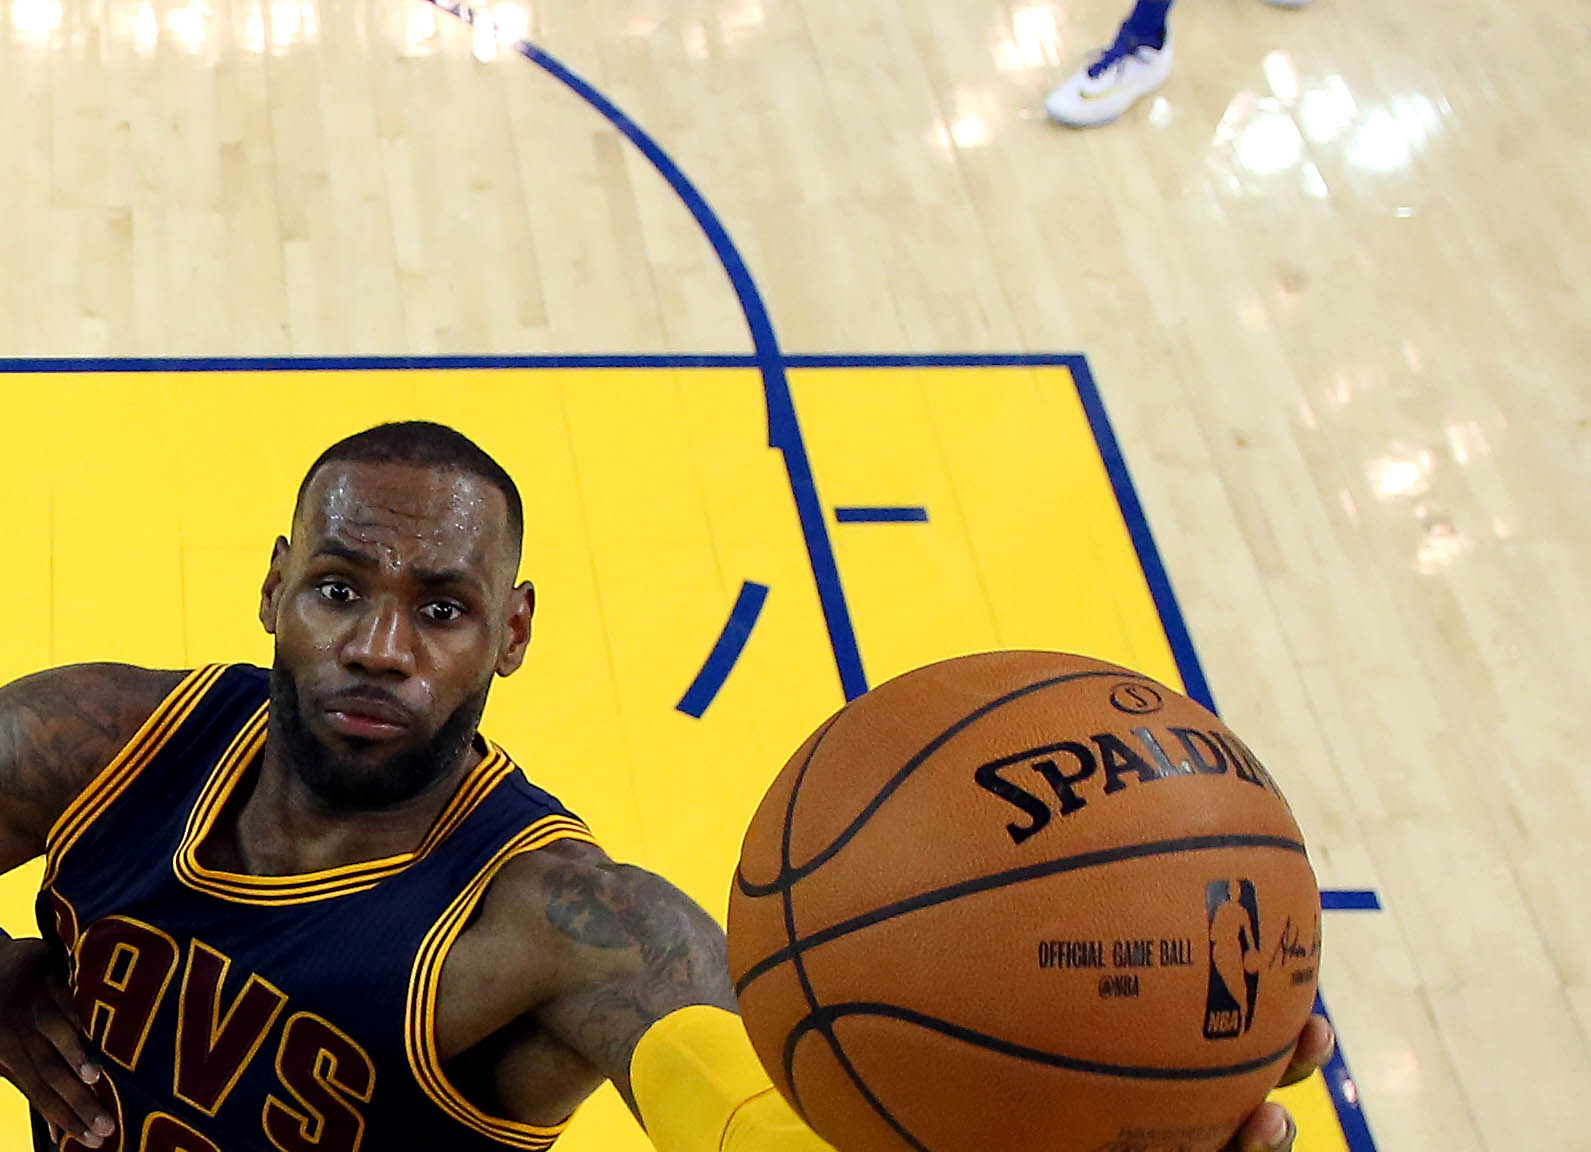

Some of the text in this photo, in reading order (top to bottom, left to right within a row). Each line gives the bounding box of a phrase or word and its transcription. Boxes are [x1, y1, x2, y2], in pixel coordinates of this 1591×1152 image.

[974, 727, 1284, 845] SPALDI
[1038, 937, 1194, 969] OFFICIAL GAME BALL
[1099, 974, 1139, 998] @NBA
[1208, 1008, 1240, 1034] NBA
